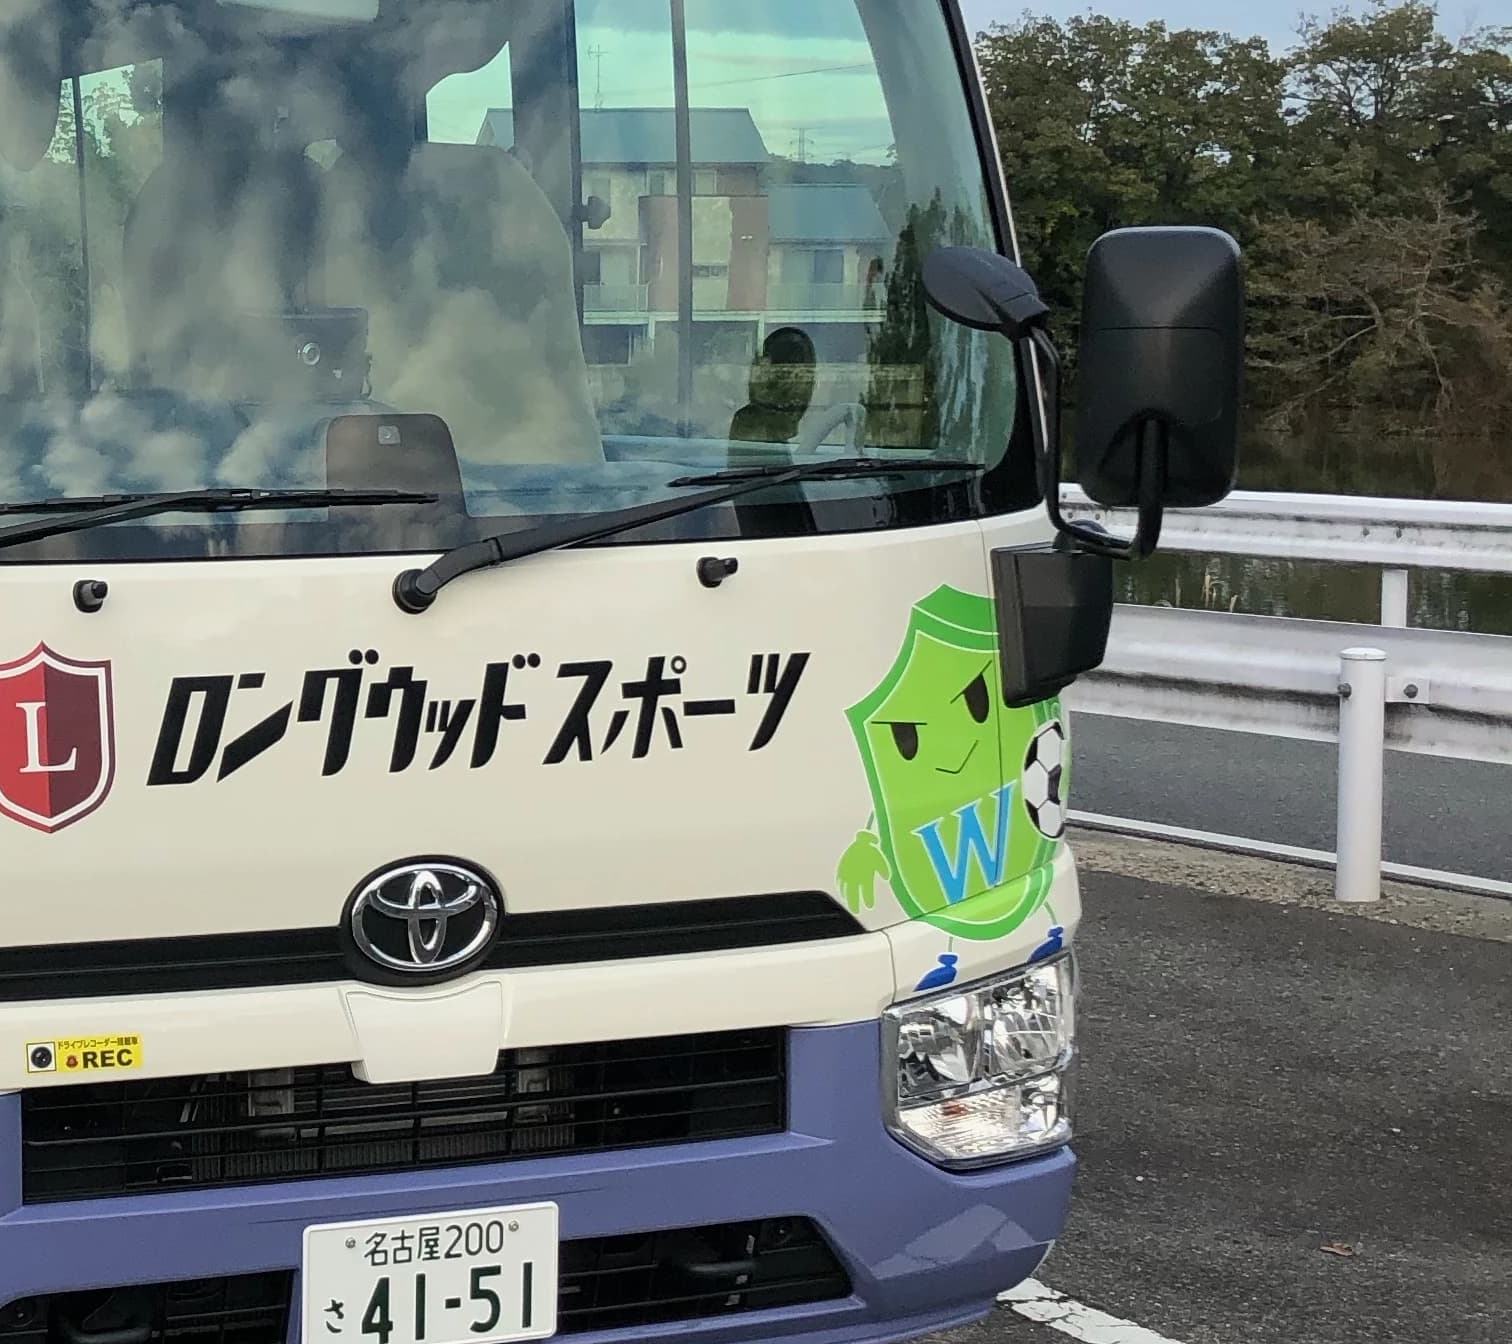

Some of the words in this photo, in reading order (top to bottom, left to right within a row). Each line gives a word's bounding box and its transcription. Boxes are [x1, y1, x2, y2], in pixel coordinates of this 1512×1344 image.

[16, 702, 77, 773] L
[146, 648, 811, 787] ロングウッドスポーツ
[910, 779, 1018, 904] W
[83, 1049, 133, 1069] REC
[364, 1220, 504, 1266] 名古屋200
[324, 1299, 344, 1334] さ
[361, 1261, 533, 1344] 41-51
